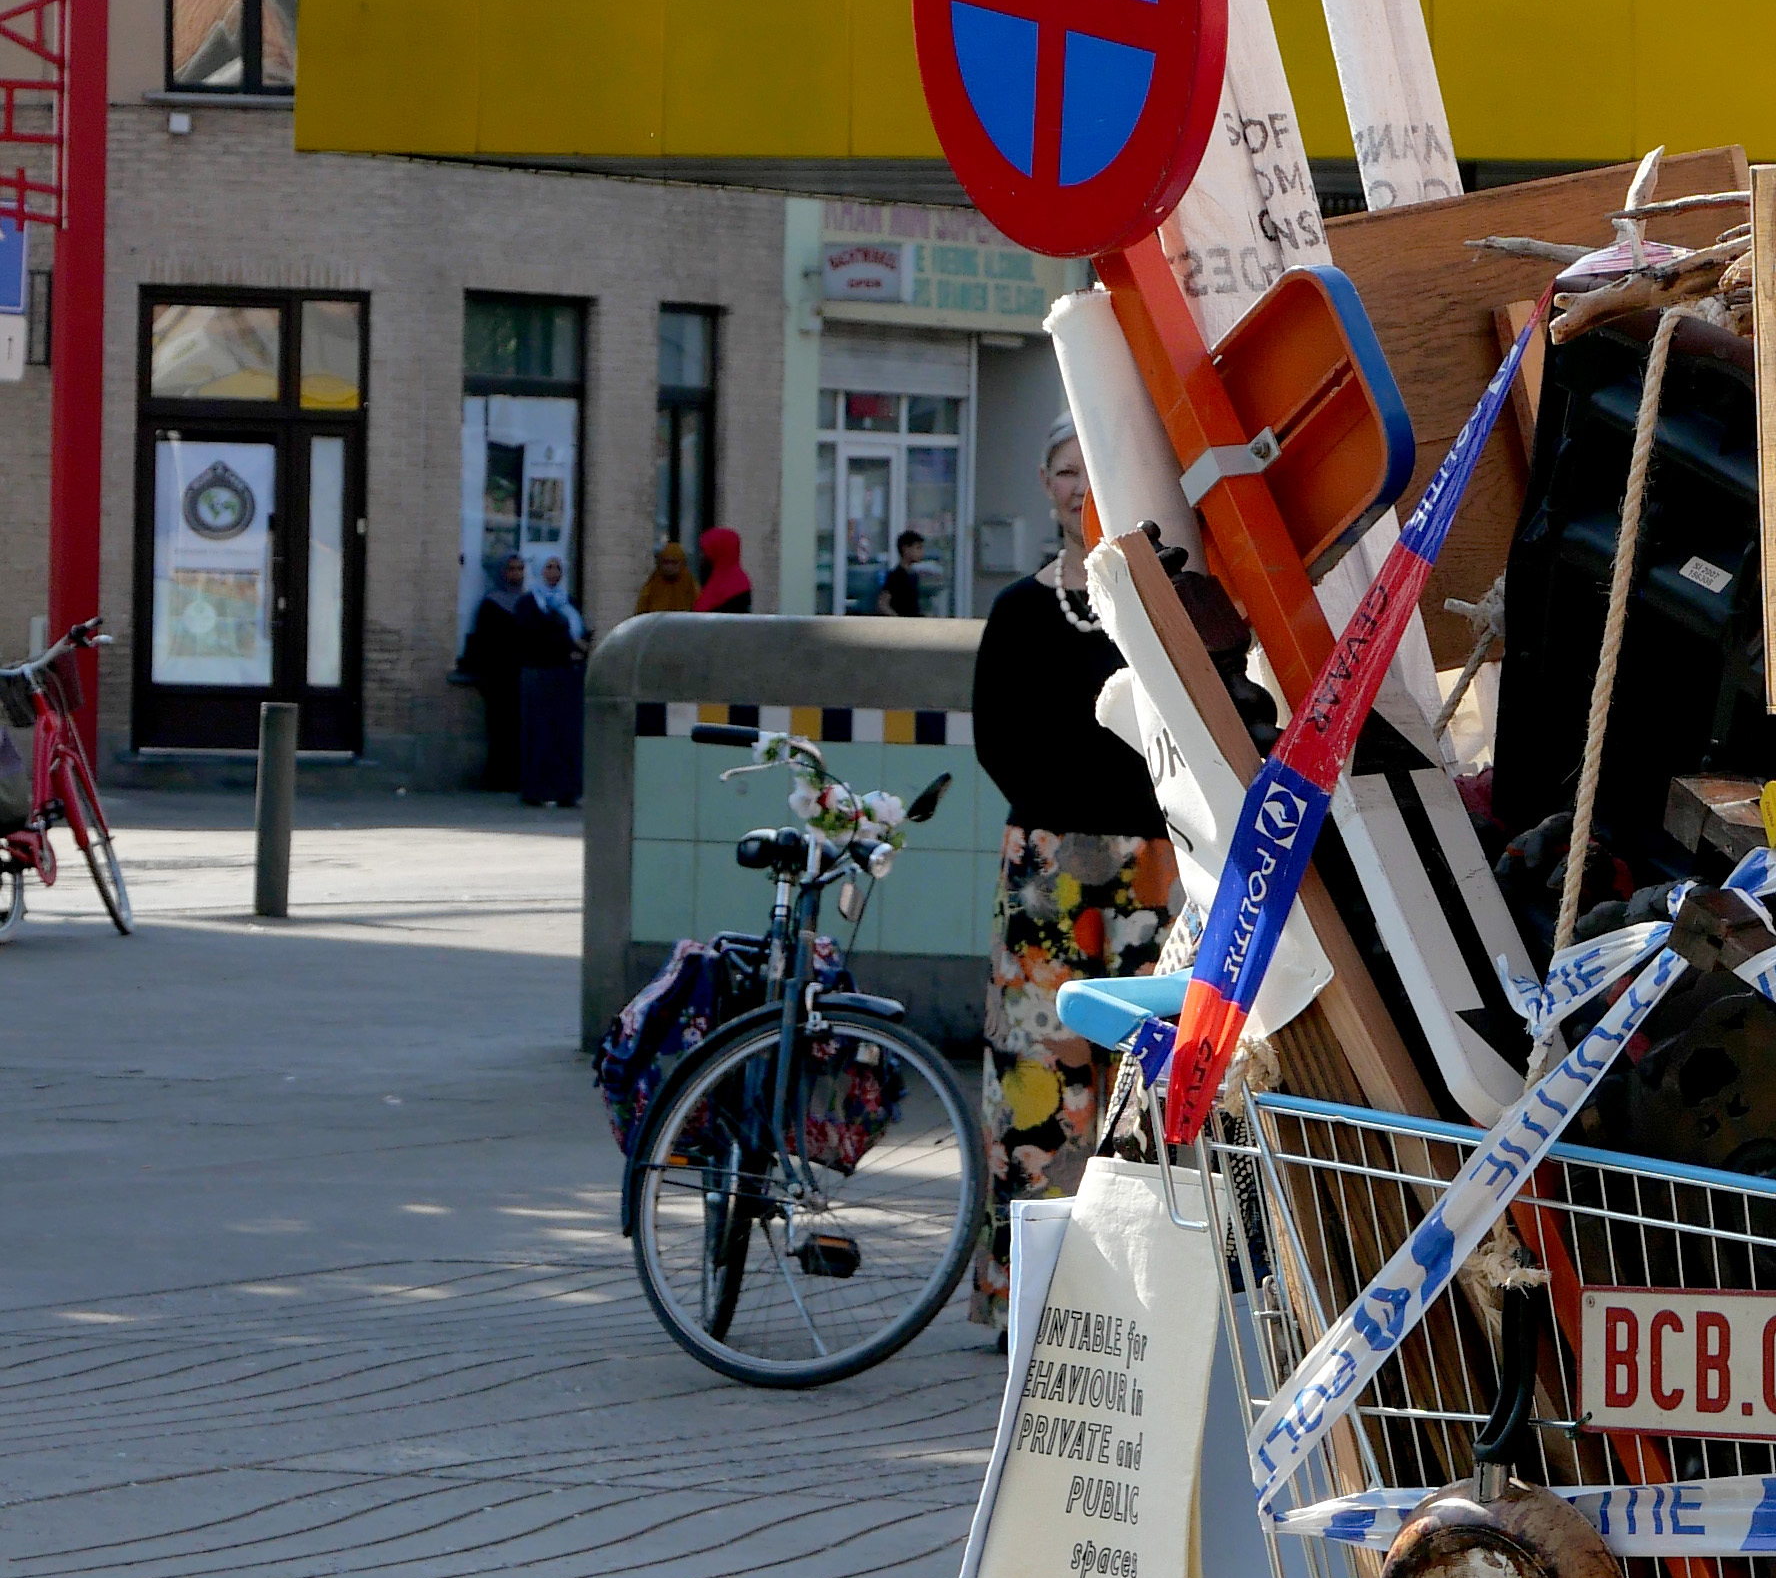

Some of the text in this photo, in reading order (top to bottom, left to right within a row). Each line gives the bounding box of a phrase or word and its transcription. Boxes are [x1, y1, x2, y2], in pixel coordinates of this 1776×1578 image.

[1305, 584, 1388, 733] GEVAAR
[1222, 848, 1276, 983] POLITIE
[1126, 1320, 1148, 1369] for
[1130, 1378, 1144, 1417] in
[1016, 1412, 1144, 1471] PRIVATE and
[1065, 1475, 1140, 1525] PUBLIC
